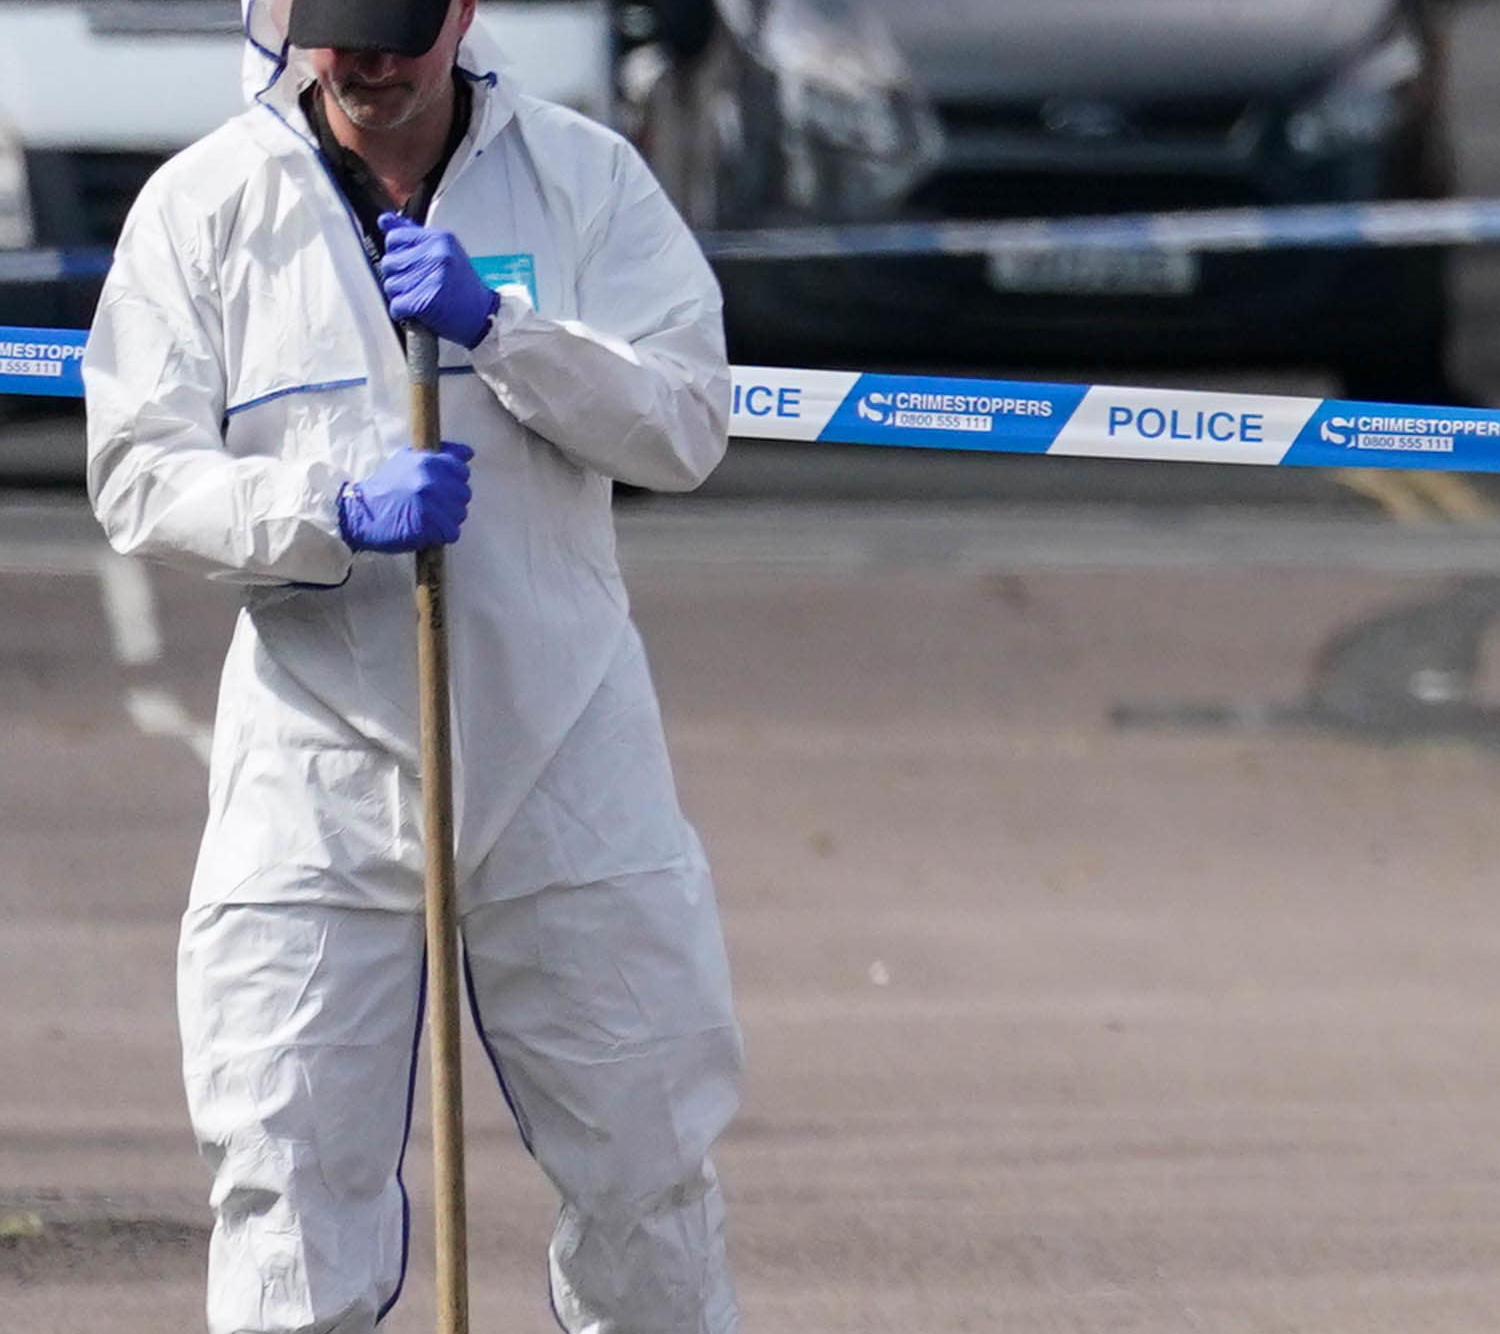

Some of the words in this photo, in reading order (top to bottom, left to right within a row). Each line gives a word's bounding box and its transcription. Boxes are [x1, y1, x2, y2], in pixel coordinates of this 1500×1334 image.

[895, 392, 1053, 417] CRIMESTOPPERS
[900, 413, 932, 428] 0800
[937, 415, 961, 429] 555
[965, 416, 989, 430] 111
[1107, 406, 1264, 444] POLICE
[1362, 435, 1395, 448] 0800
[1398, 436, 1424, 450] 555
[1427, 437, 1450, 451] 111
